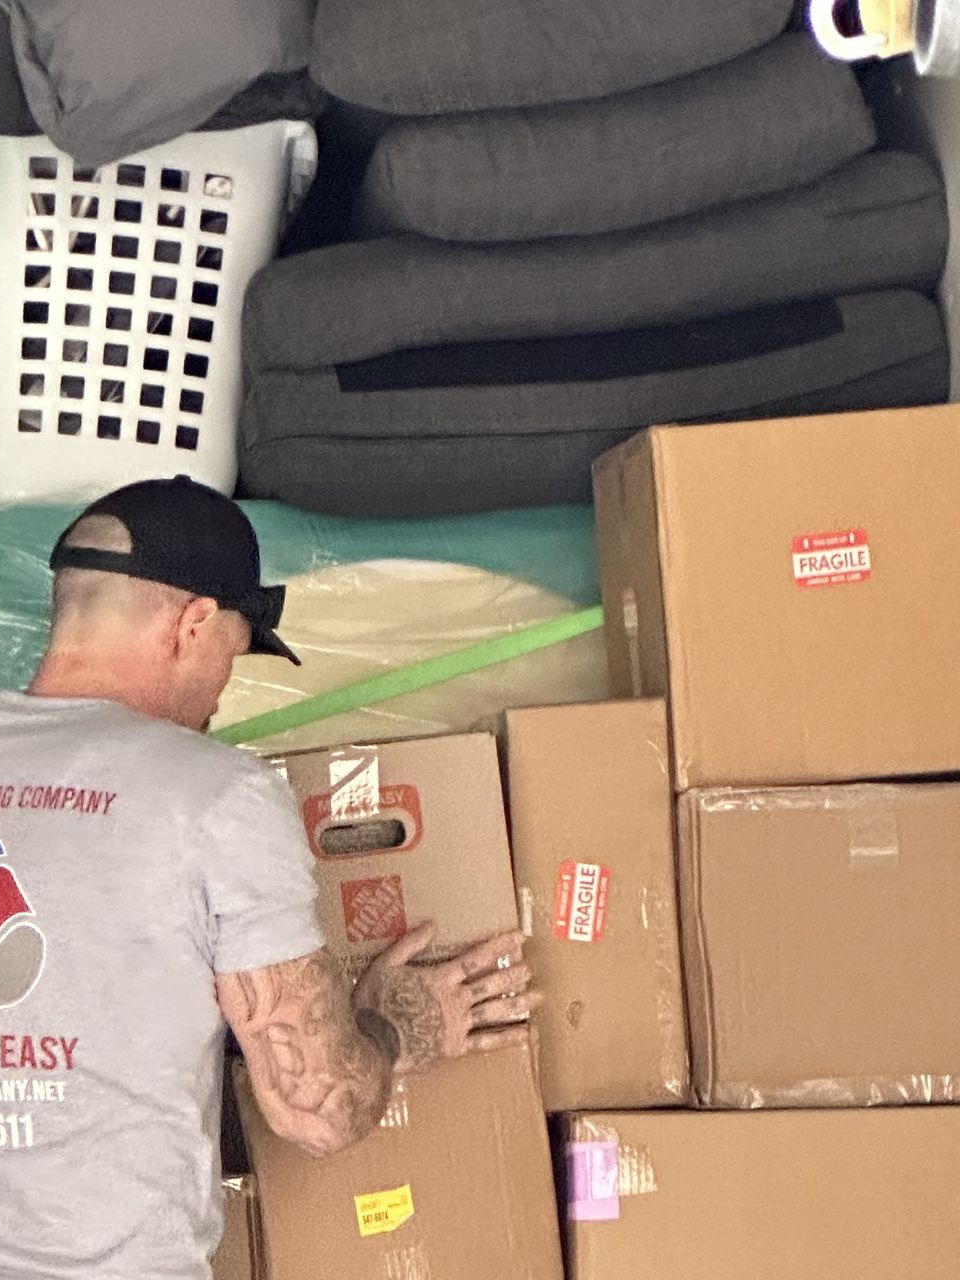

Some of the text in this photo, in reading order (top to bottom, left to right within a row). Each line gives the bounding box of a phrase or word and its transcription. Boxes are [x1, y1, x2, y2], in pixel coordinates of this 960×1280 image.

[799, 551, 866, 573] FRAGILE
[18, 785, 117, 816] COMPANY
[573, 867, 596, 935] FRAGILE
[0, 1032, 79, 1071] EASY
